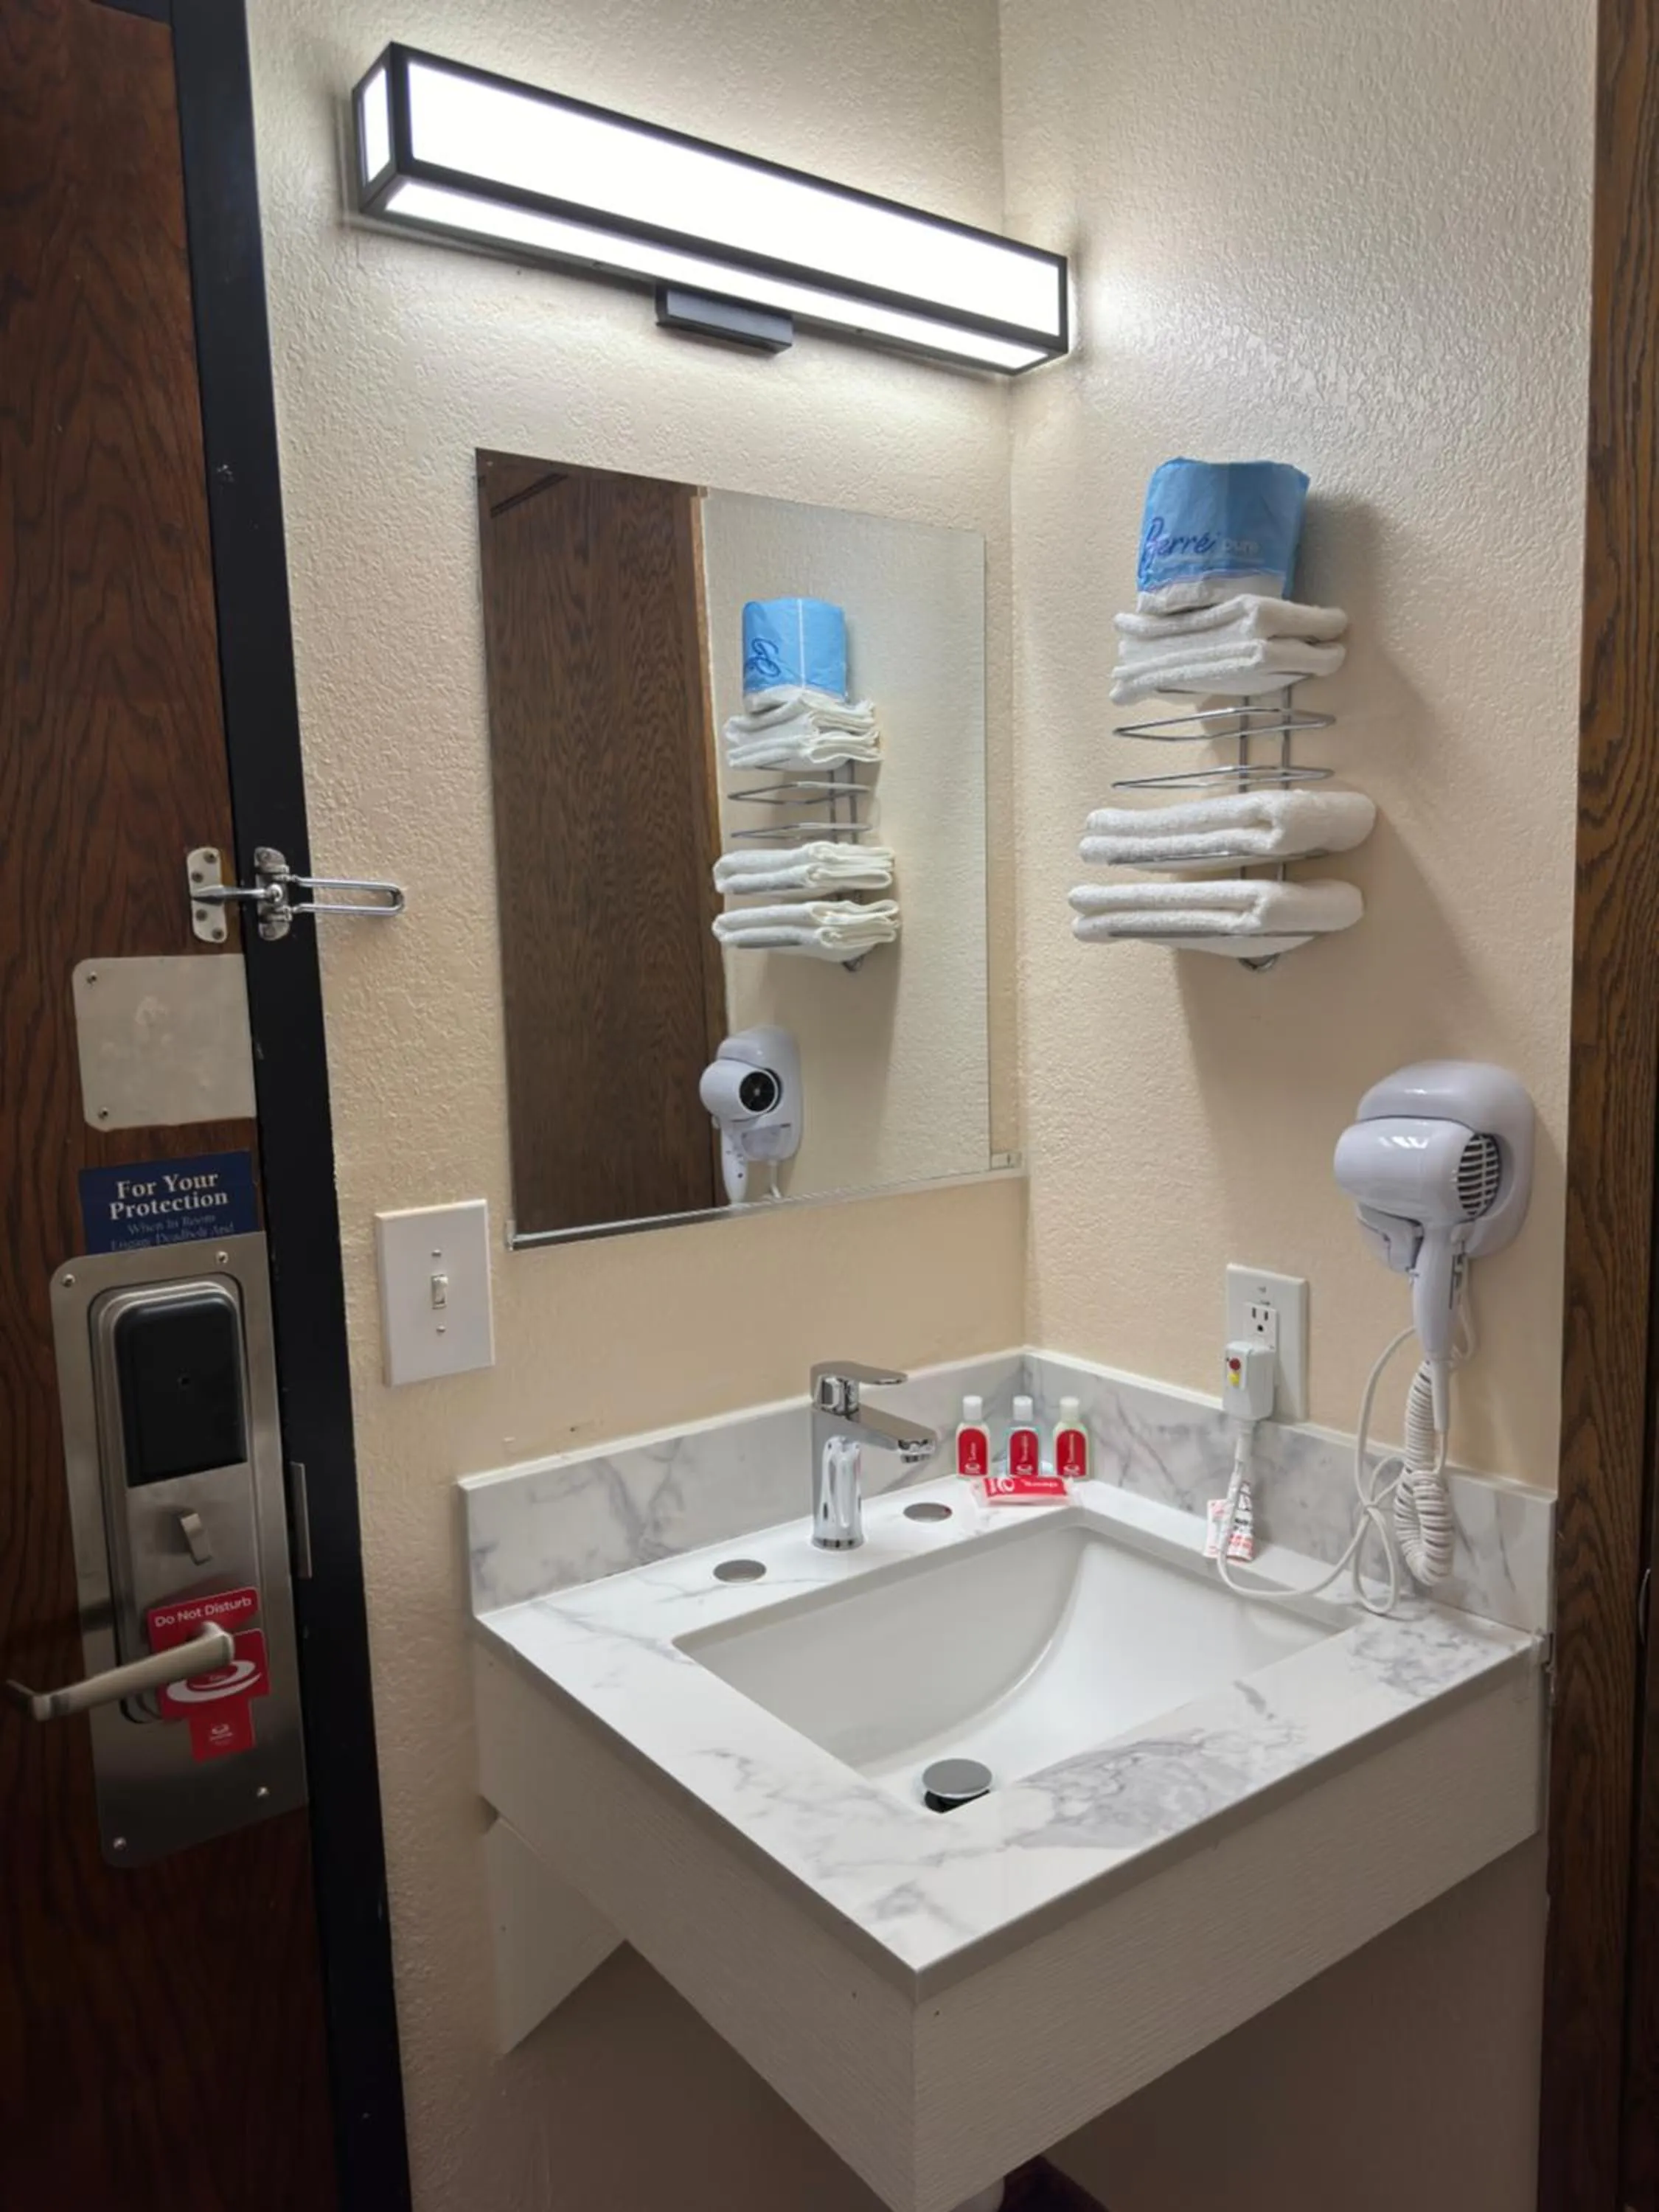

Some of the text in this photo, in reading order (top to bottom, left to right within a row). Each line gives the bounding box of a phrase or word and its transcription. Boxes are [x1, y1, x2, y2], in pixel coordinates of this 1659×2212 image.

[116, 1173, 219, 1200] For Your
[109, 1191, 229, 1220] Protection
[155, 1596, 252, 1627] Do Not Disturb
